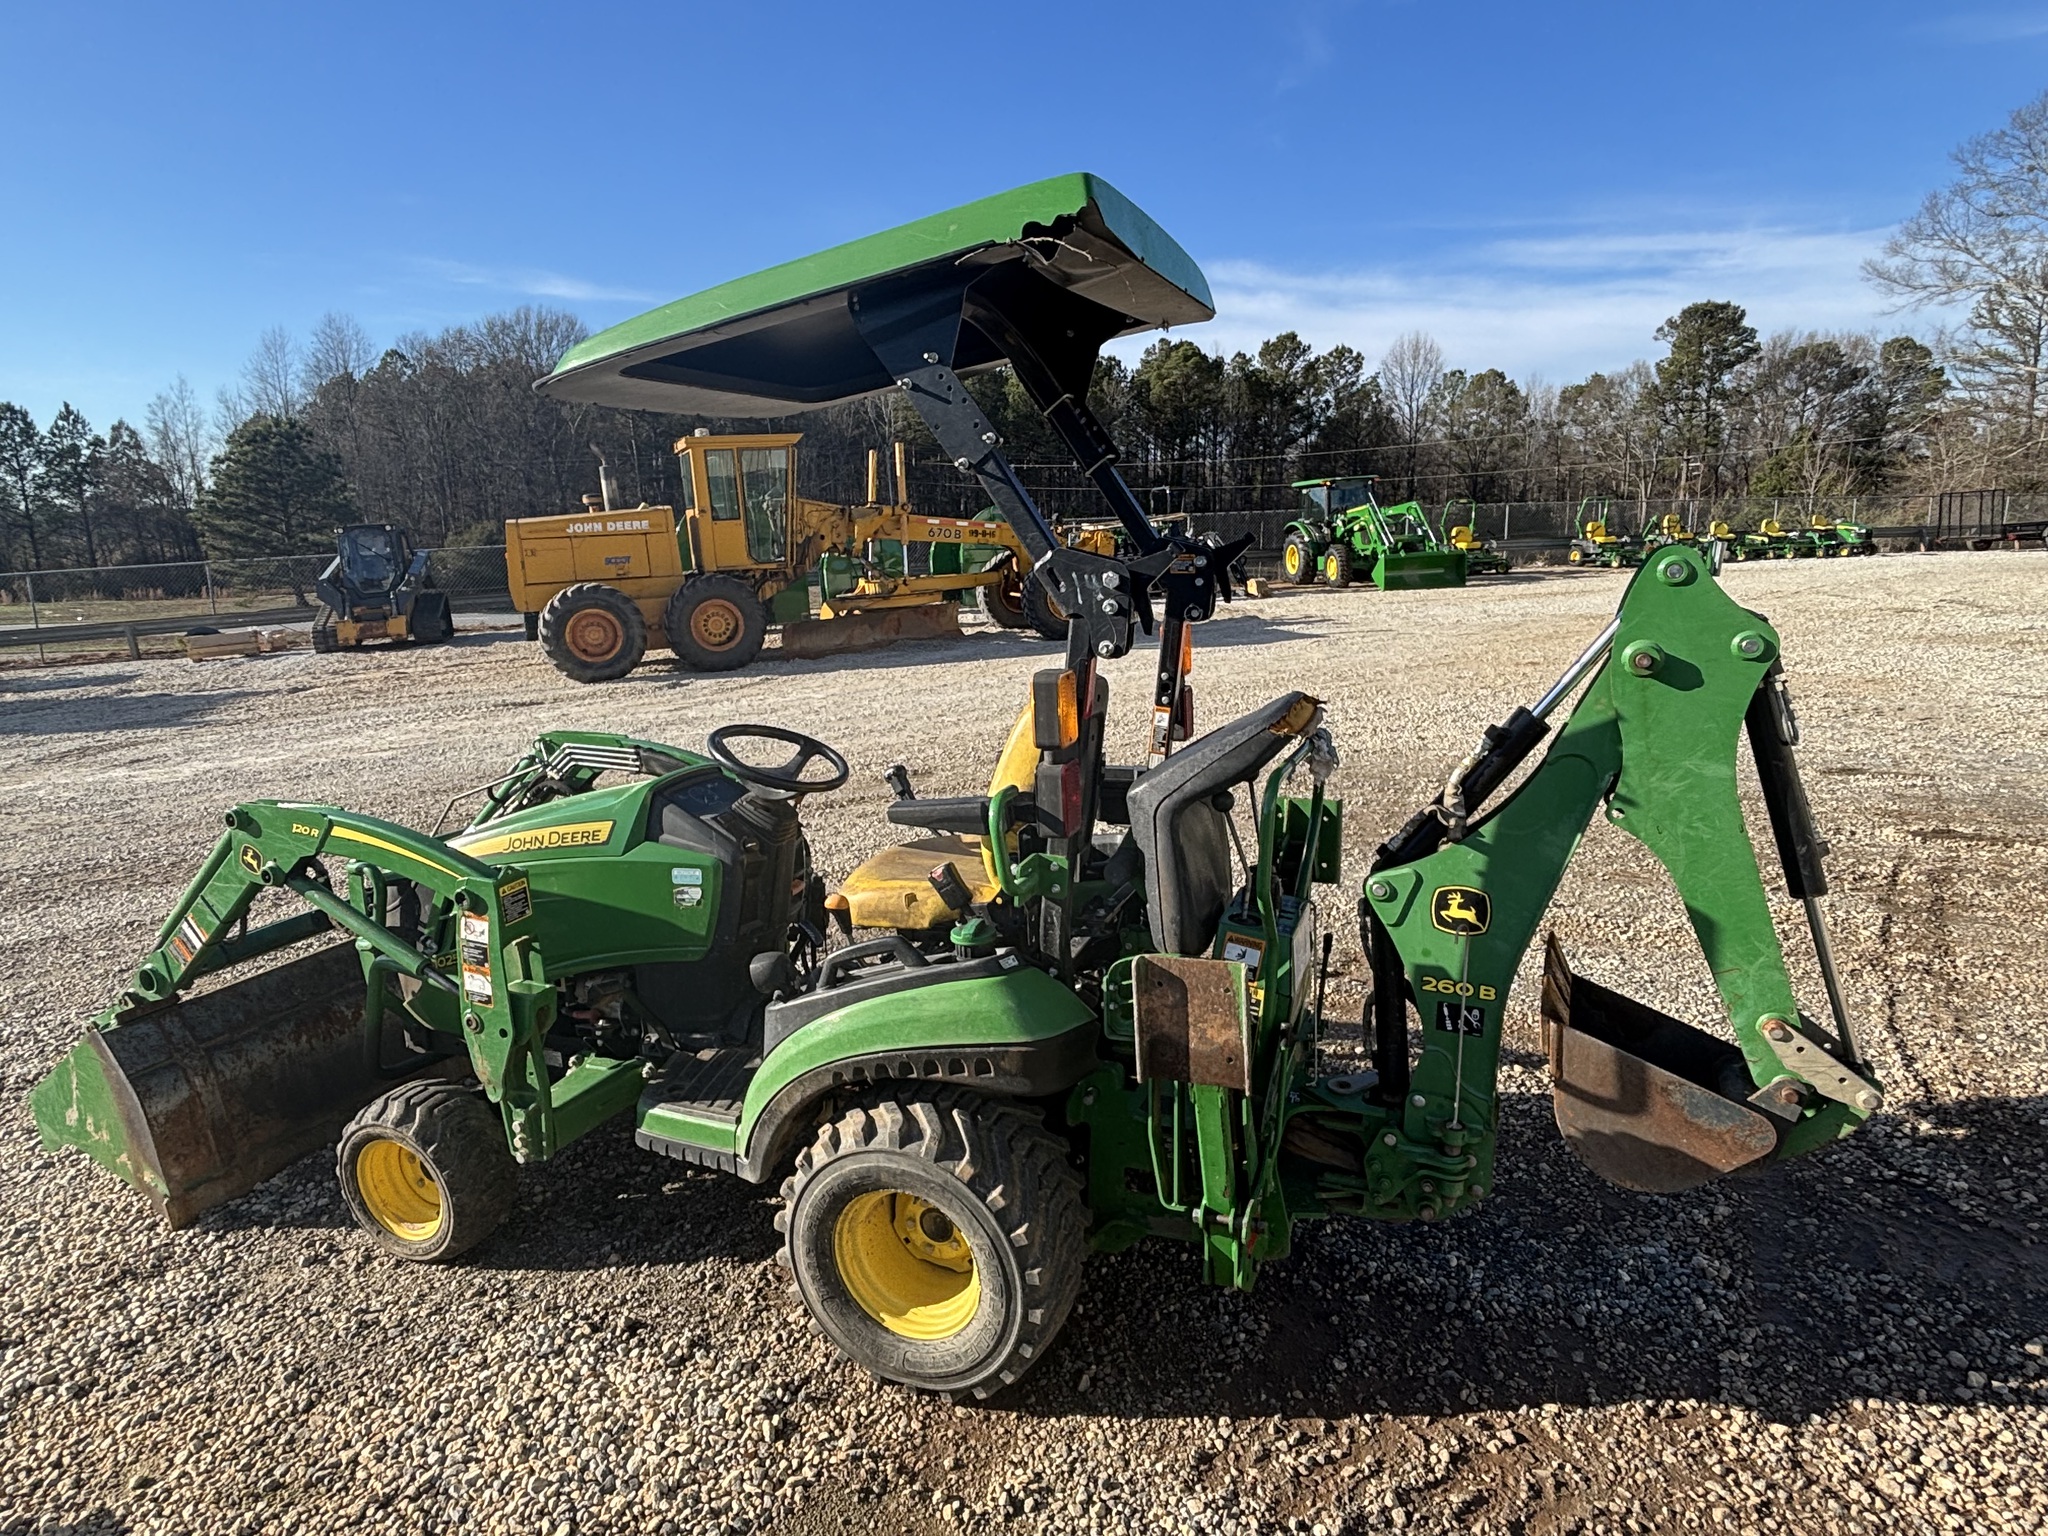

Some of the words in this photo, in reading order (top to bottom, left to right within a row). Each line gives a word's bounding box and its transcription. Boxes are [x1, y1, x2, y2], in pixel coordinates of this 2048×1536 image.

[566, 522, 603, 534] JOHN
[607, 520, 650, 532] DEERE
[503, 835, 545, 852] JOHN
[548, 829, 602, 847] DEERE
